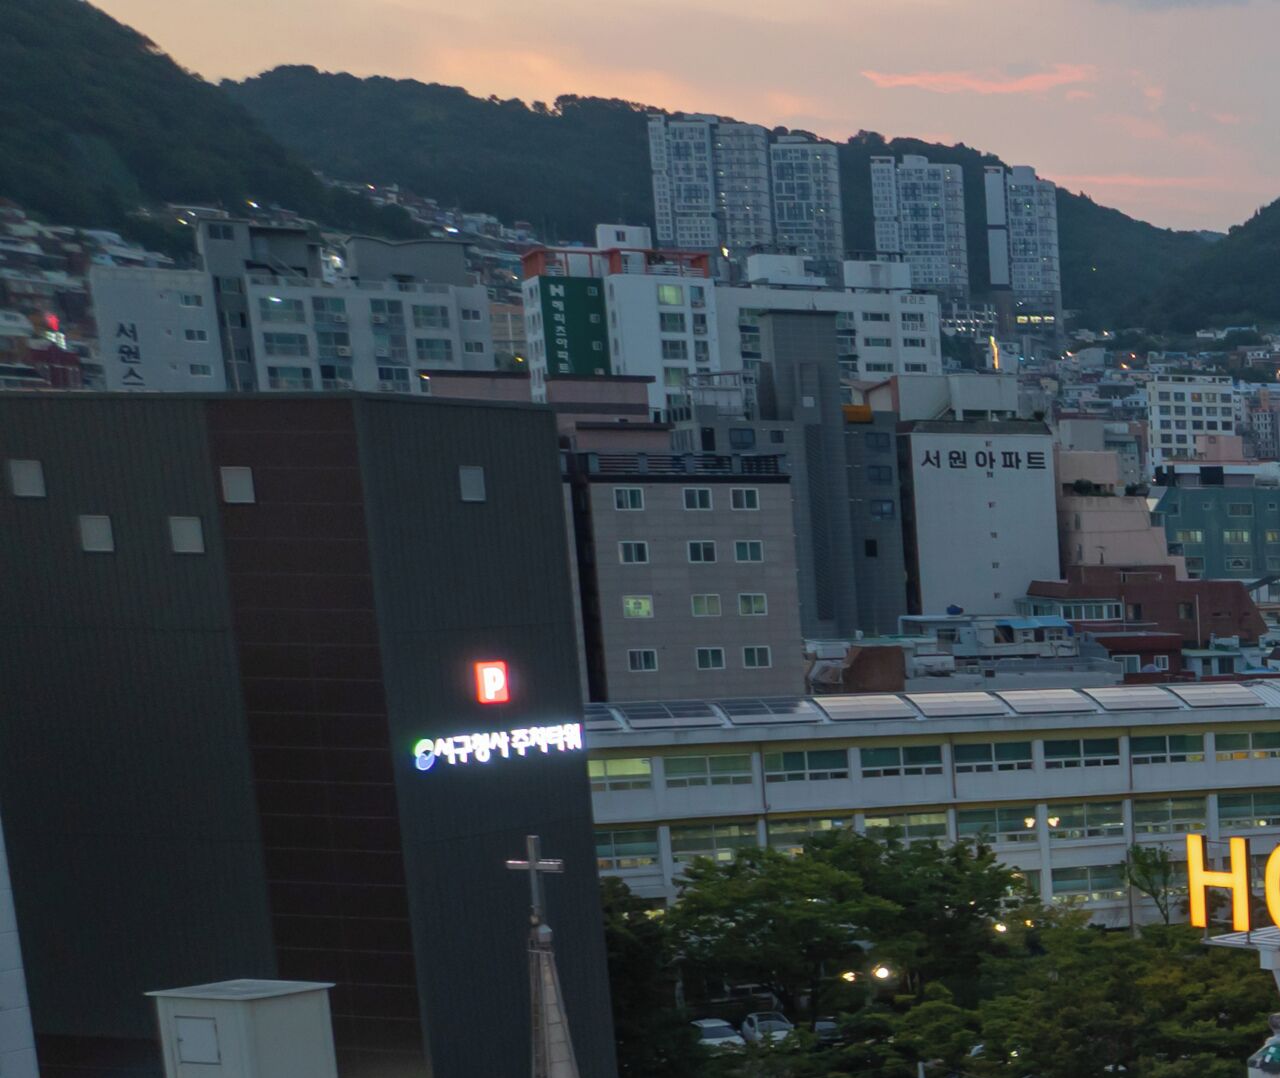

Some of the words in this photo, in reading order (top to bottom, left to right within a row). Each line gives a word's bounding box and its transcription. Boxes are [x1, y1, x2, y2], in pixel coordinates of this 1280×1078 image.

[921, 450, 1047, 469] 서원아파트
[483, 667, 505, 700] P
[433, 731, 509, 765] 서구청사
[510, 723, 582, 756] 주차타워
